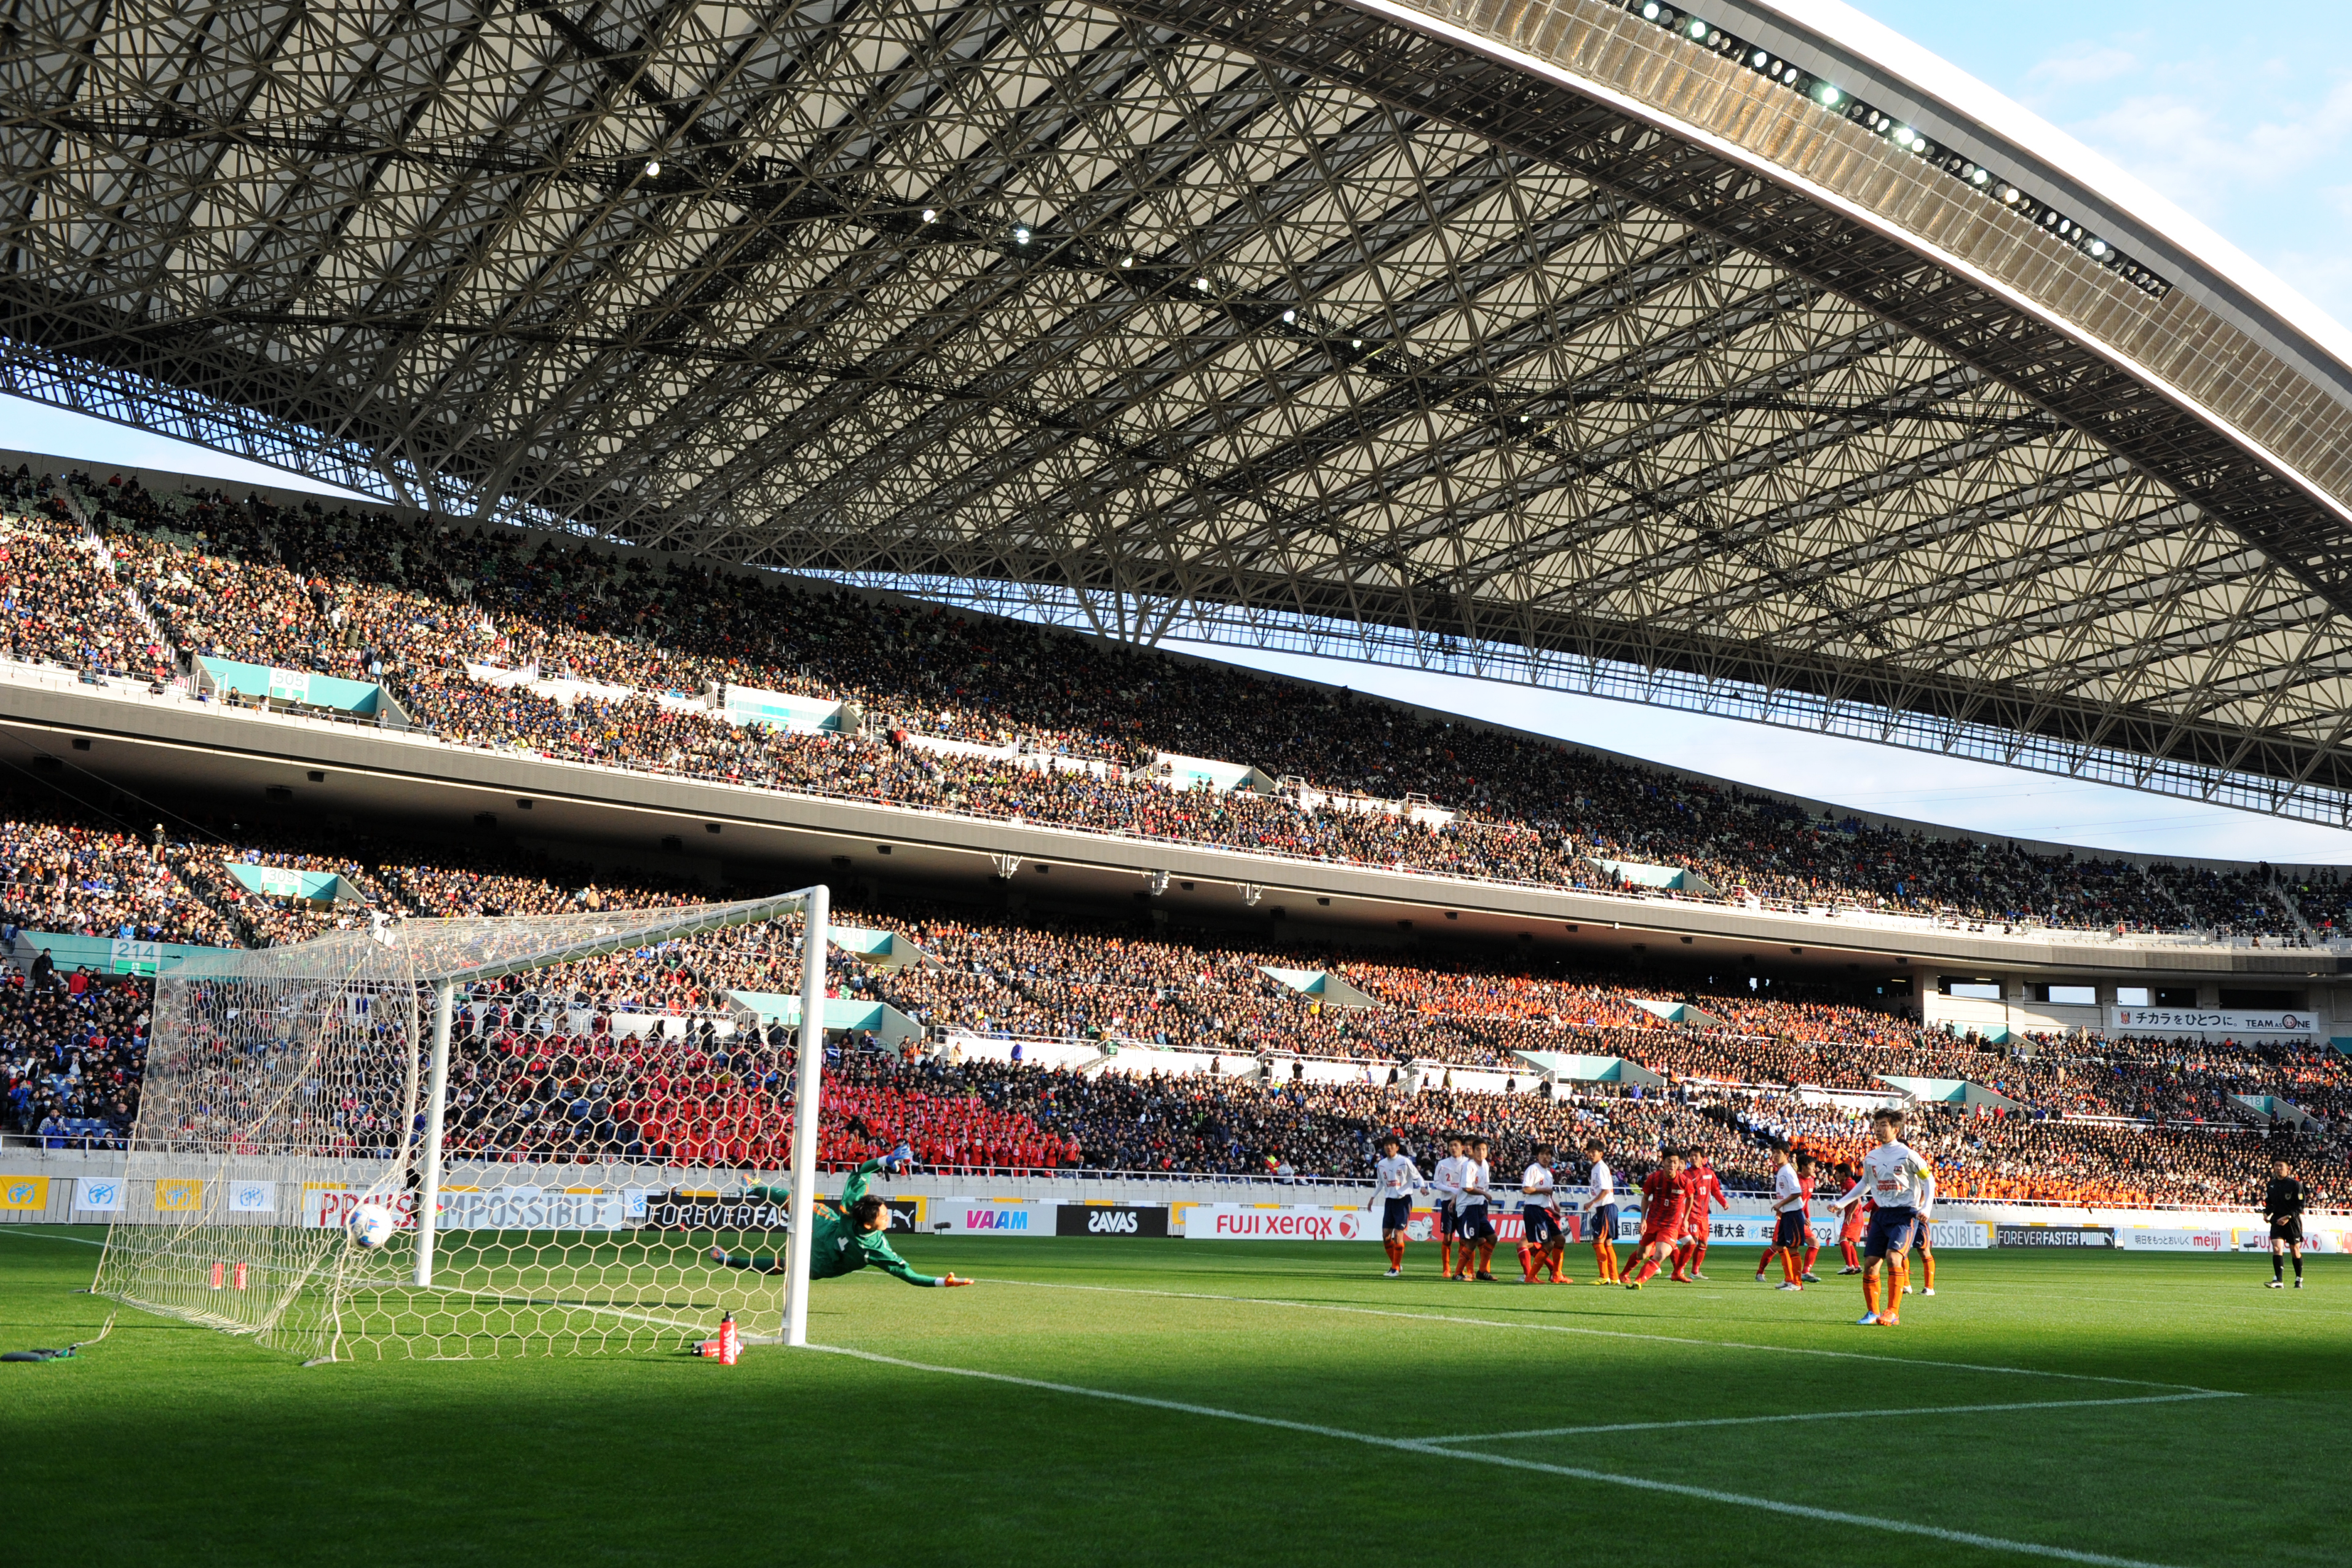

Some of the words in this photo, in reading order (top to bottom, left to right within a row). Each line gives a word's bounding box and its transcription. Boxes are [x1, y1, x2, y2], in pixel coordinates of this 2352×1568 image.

[274, 671, 304, 687] 505
[269, 869, 295, 882] 309
[841, 929, 861, 940] 310
[117, 942, 154, 960] 214
[1559, 1056, 1577, 1066] 216
[1912, 1080, 1928, 1089] 217
[2243, 1096, 2261, 1106] 218
[1699, 1186, 1706, 1195] 13
[966, 1210, 1028, 1229] VAAM
[1088, 1211, 1138, 1233] SAVAS
[1217, 1215, 1259, 1233] FUJI
[1469, 1227, 1475, 1237] 6
[1690, 1224, 1697, 1232] 13
[1540, 1230, 1548, 1240] 8
[1931, 1225, 1981, 1247] OSSIBLE
[2080, 1232, 2105, 1245] PUMA
[2135, 1235, 2189, 1245] 明日をもっとおいしく
[2193, 1232, 2220, 1250] meiji
